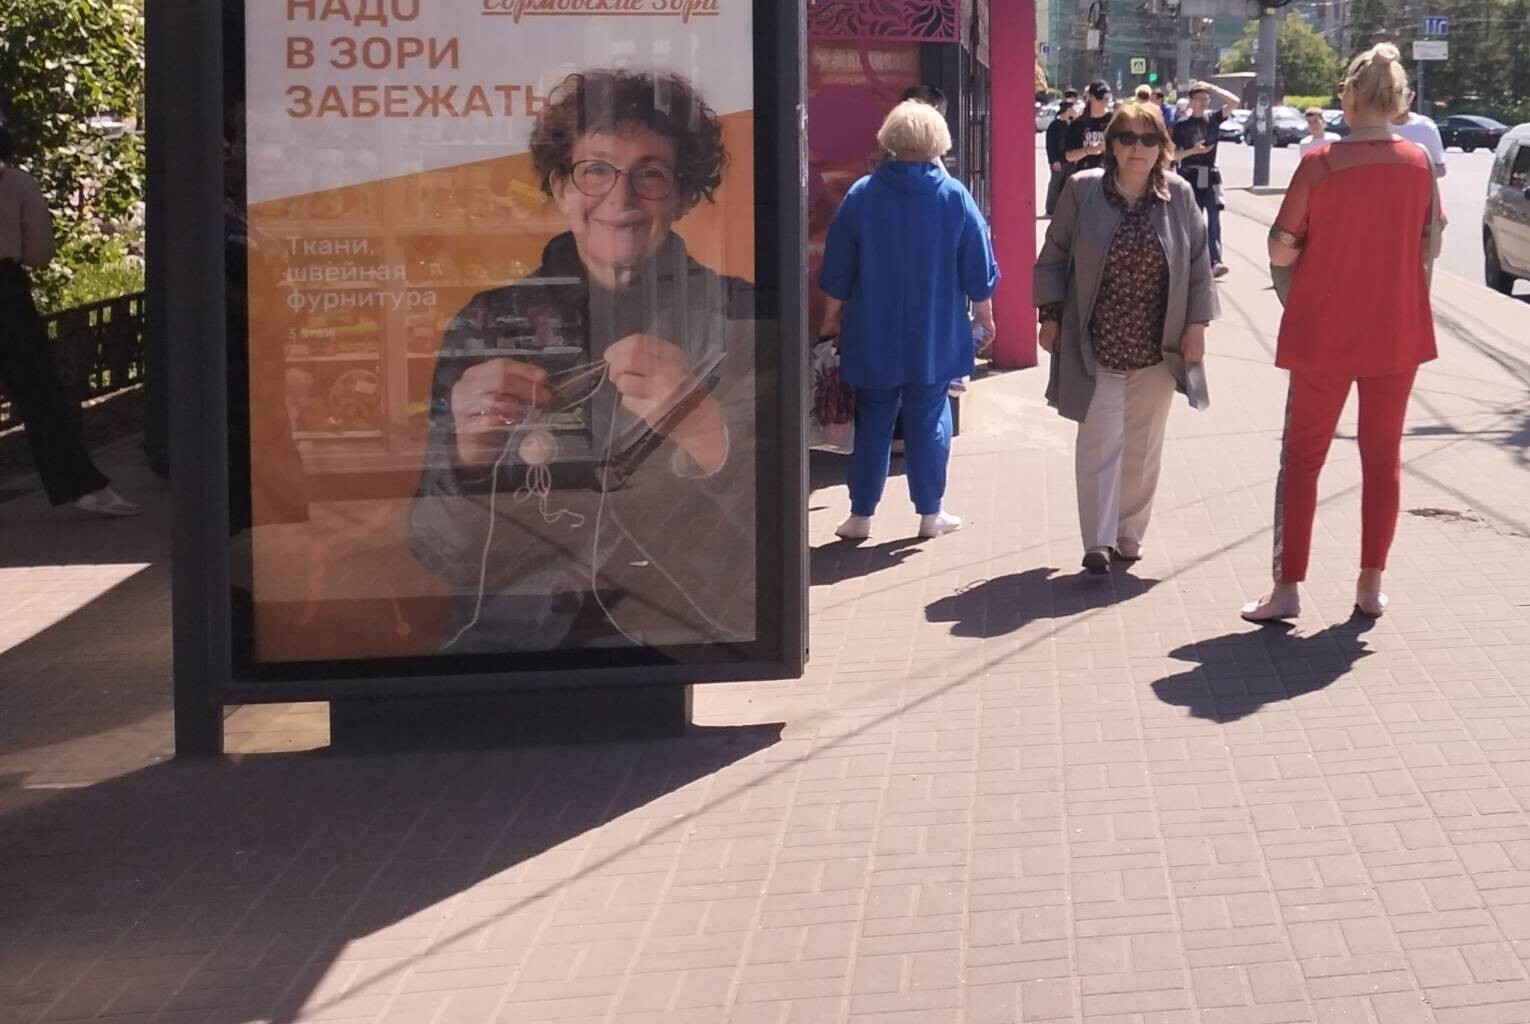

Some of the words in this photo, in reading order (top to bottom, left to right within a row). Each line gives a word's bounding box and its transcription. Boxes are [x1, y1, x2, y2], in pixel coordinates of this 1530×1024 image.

[286, 36, 315, 70] В
[329, 36, 460, 70] ЗОРИ
[285, 85, 550, 119] ЗАБЕЖАТЬ
[286, 235, 377, 257] Ткани,
[286, 261, 407, 282] швейная
[286, 288, 438, 313] фурнитура
